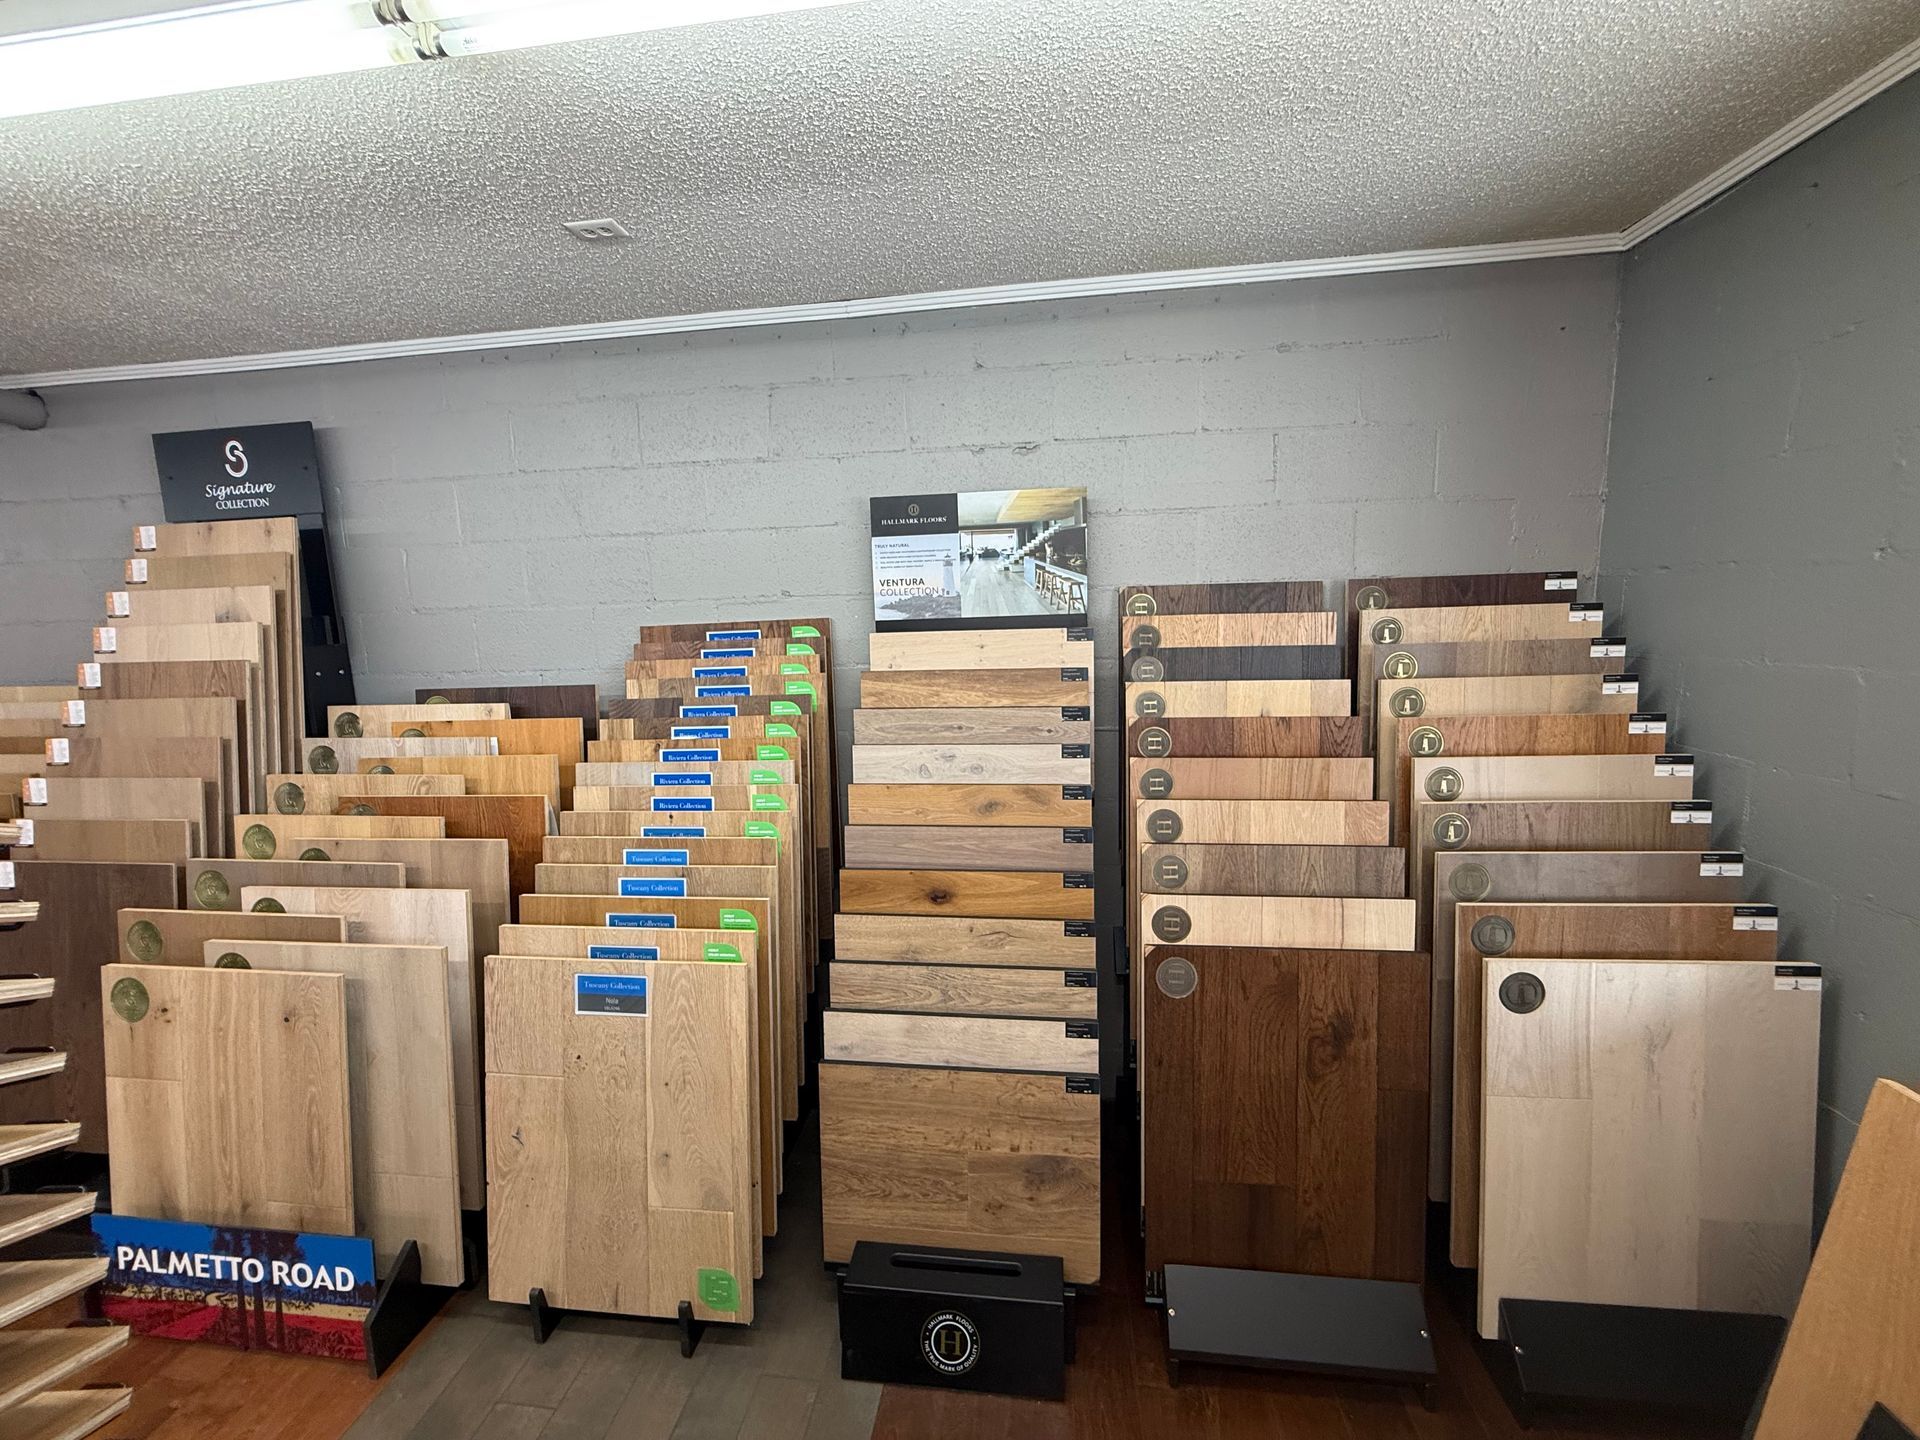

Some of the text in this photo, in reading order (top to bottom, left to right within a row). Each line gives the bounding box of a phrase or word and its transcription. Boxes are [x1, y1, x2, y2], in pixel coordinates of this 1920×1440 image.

[205, 481, 276, 501] Signature
[215, 497, 270, 510] COLLECTION
[881, 516, 947, 526] HALLMARK FLOORS
[879, 577, 925, 587] VENTURA
[880, 586, 939, 597] COLLECTION
[631, 855, 682, 863] Tuscany Collection
[627, 884, 679, 893] Tuscany Collection
[614, 919, 670, 927] Tuscany Collection
[621, 951, 653, 960] Collection
[584, 981, 641, 990] Tuscany Collection
[116, 1245, 355, 1292] PALMETTO ROAD
[927, 1314, 974, 1334] HALLMARK FLOORS
[939, 1329, 963, 1356] H
[928, 1351, 940, 1367] TRUE
[939, 1363, 956, 1372] MARK
[964, 1344, 978, 1368] QUALITY
